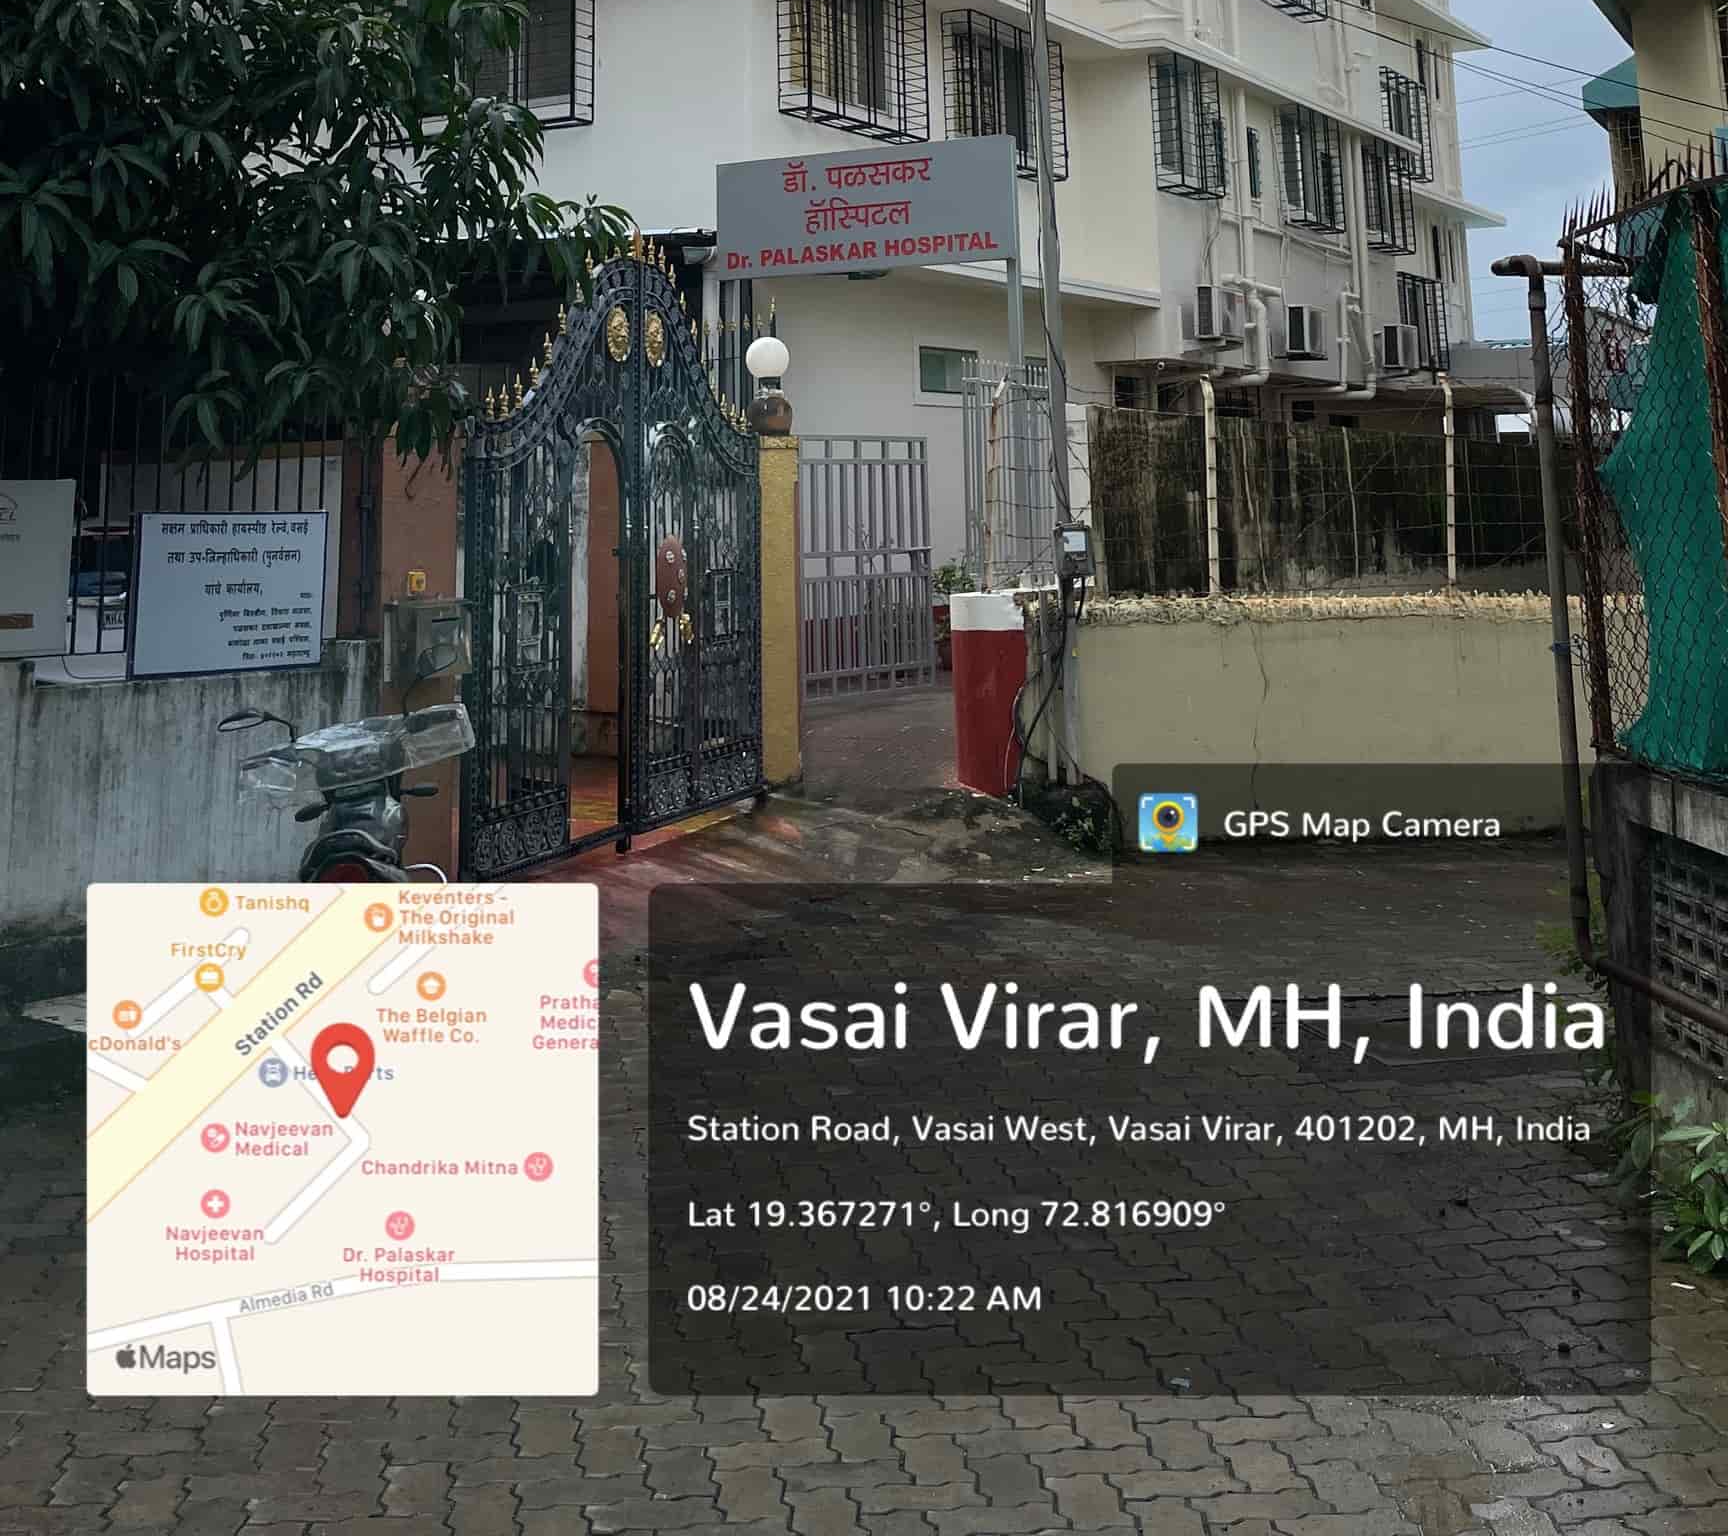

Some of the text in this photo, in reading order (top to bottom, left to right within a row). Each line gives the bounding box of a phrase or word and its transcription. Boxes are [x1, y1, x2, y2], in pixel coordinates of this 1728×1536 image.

[782, 158, 932, 193] डॉ. पळसकर
[805, 198, 912, 233] हॉस्पिटल
[727, 231, 998, 270] Dr. PALASKAR HOSPITAL
